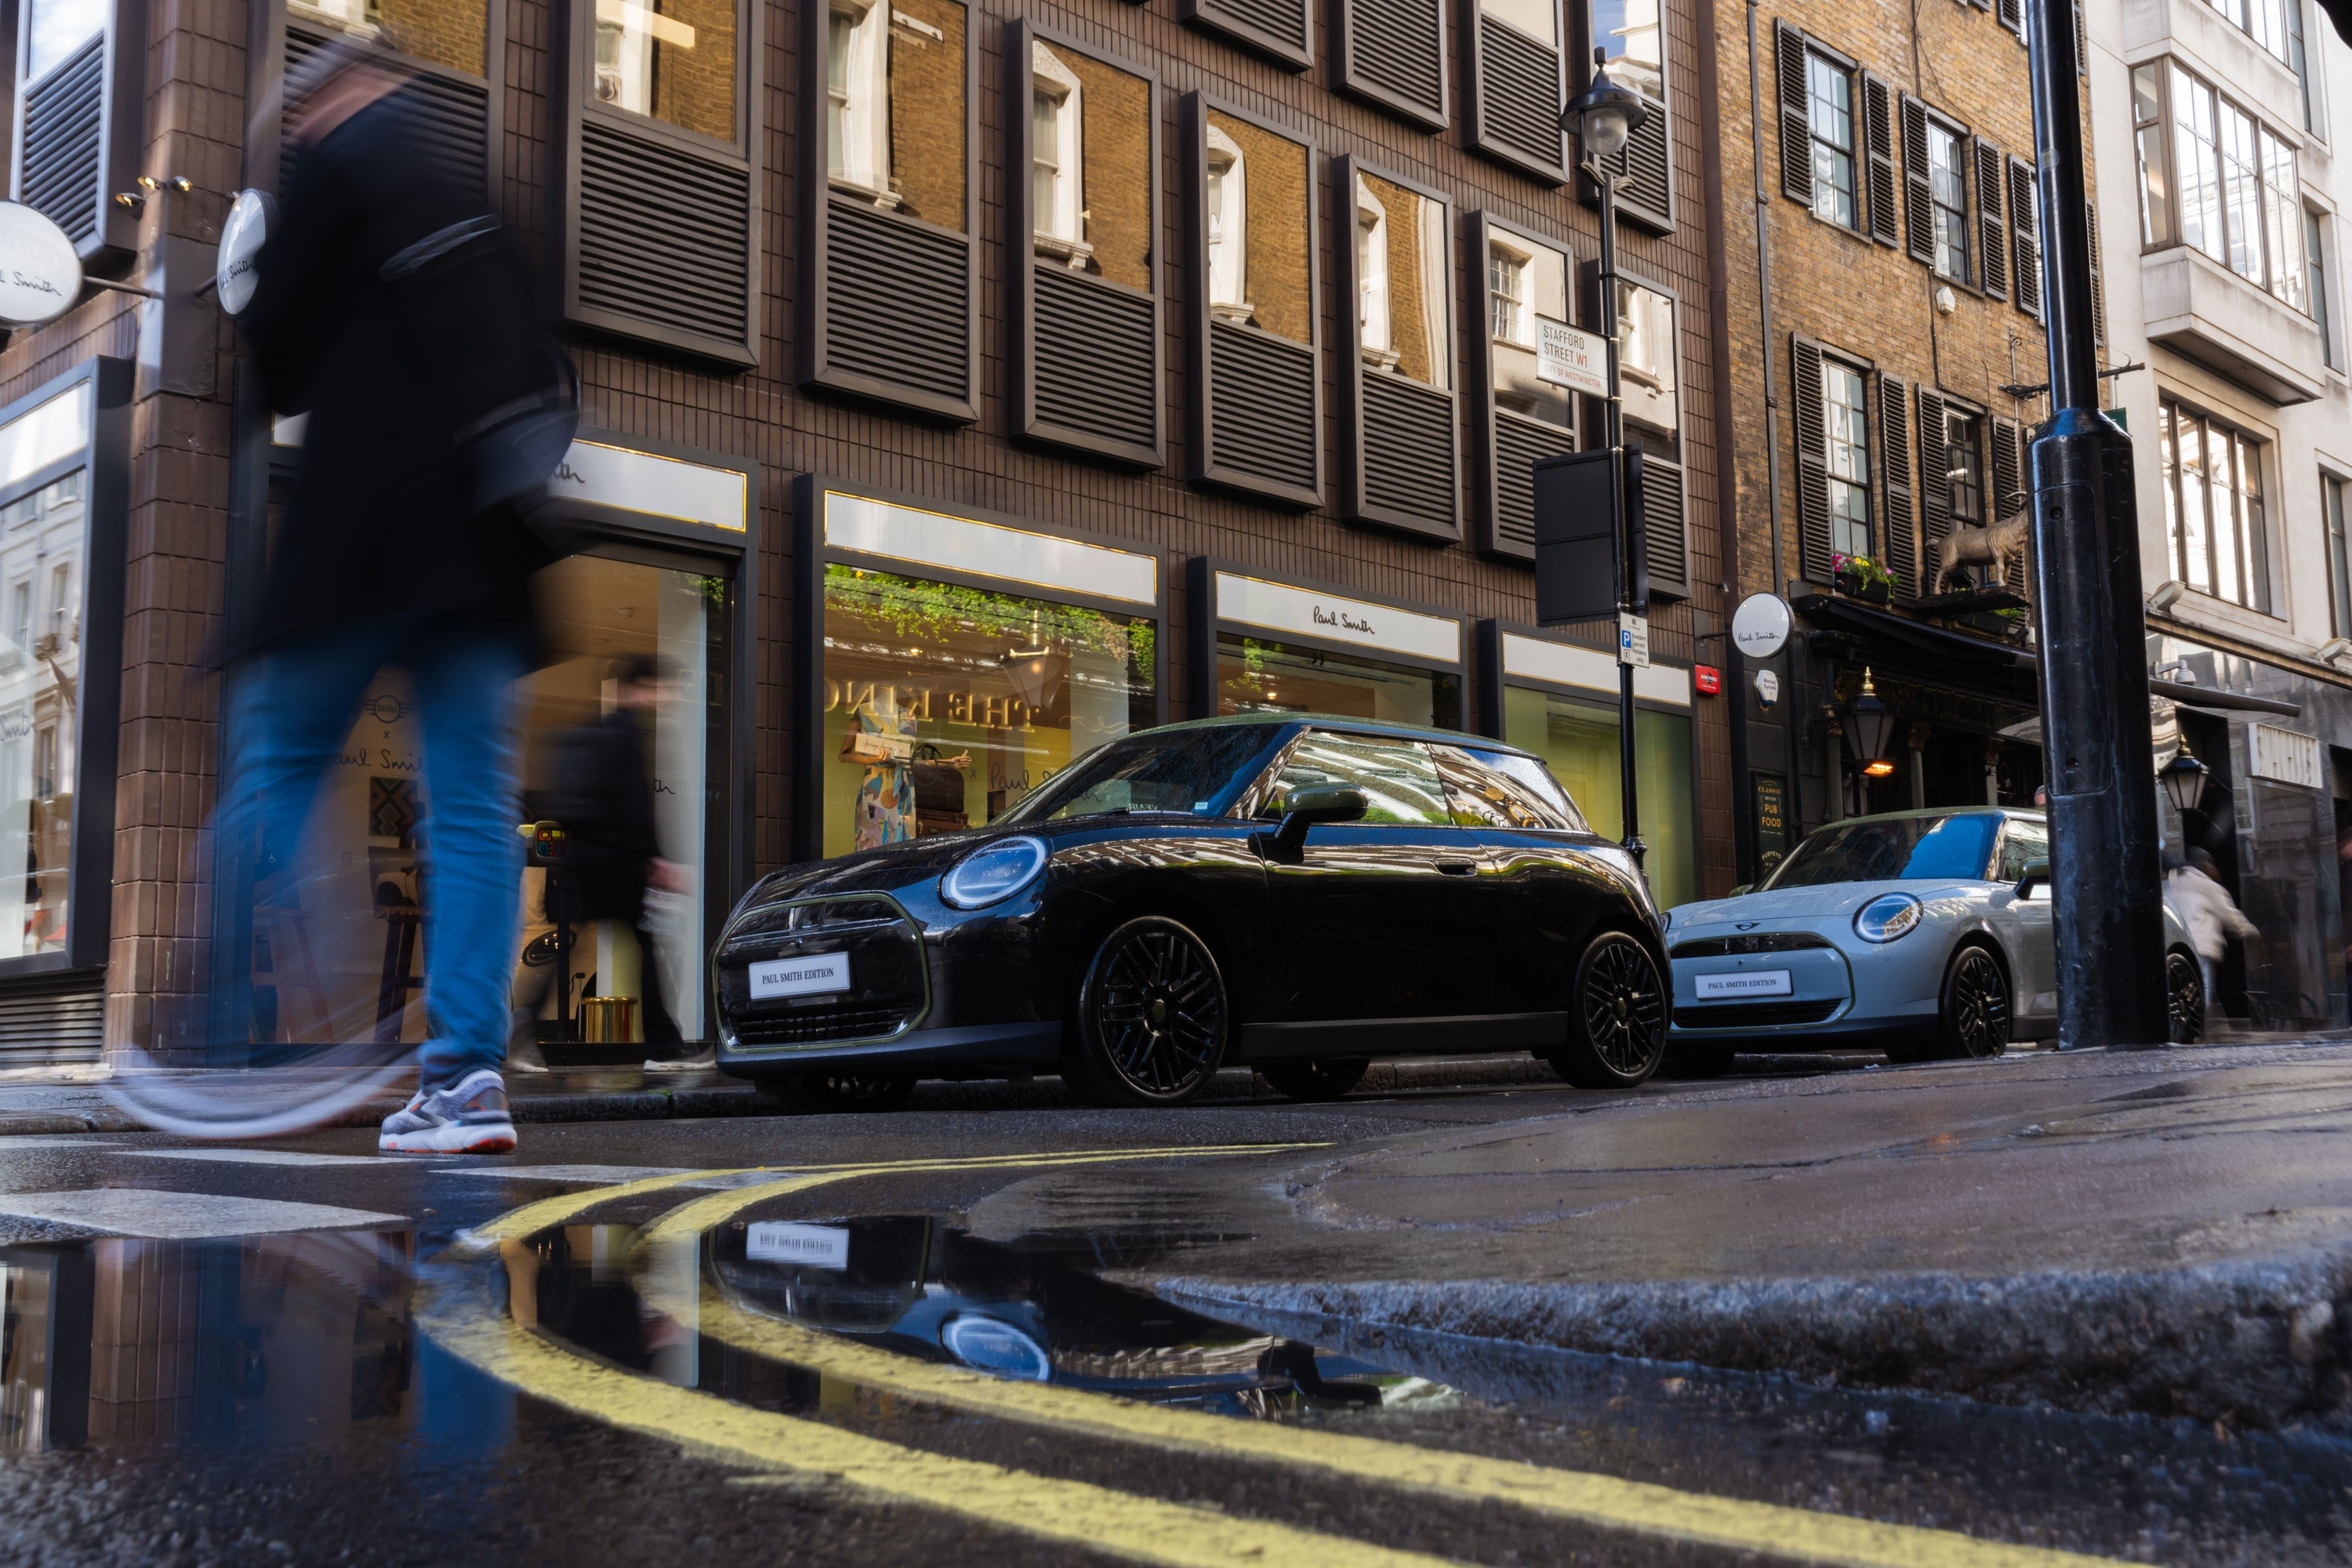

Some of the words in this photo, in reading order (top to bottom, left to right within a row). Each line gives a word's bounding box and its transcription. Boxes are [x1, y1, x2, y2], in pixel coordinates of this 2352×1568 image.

[13, 270, 63, 297] Smith
[1543, 325, 1584, 350] STAFFORD
[1544, 342, 1574, 363] STREET
[1576, 352, 1588, 368] W1
[1544, 364, 1556, 374] CITY
[1557, 368, 1564, 376] OF
[1565, 371, 1601, 389] WESTMINSTER
[1313, 605, 1338, 626] Paul
[1341, 612, 1376, 635] Smith
[1738, 632, 1753, 642] Paul
[1755, 631, 1780, 641] Smith
[377, 704, 397, 713] MINI
[380, 749, 426, 773] Smit
[991, 762, 1033, 791] Paul
[1758, 786, 1782, 795] CLASSIC
[1764, 803, 1778, 814] PUB
[1762, 816, 1781, 827] FOOD
[762, 974, 779, 985] PAUL
[780, 971, 803, 983] SMITH
[804, 967, 834, 980] EDITION
[1749, 978, 1777, 987] EDITION
